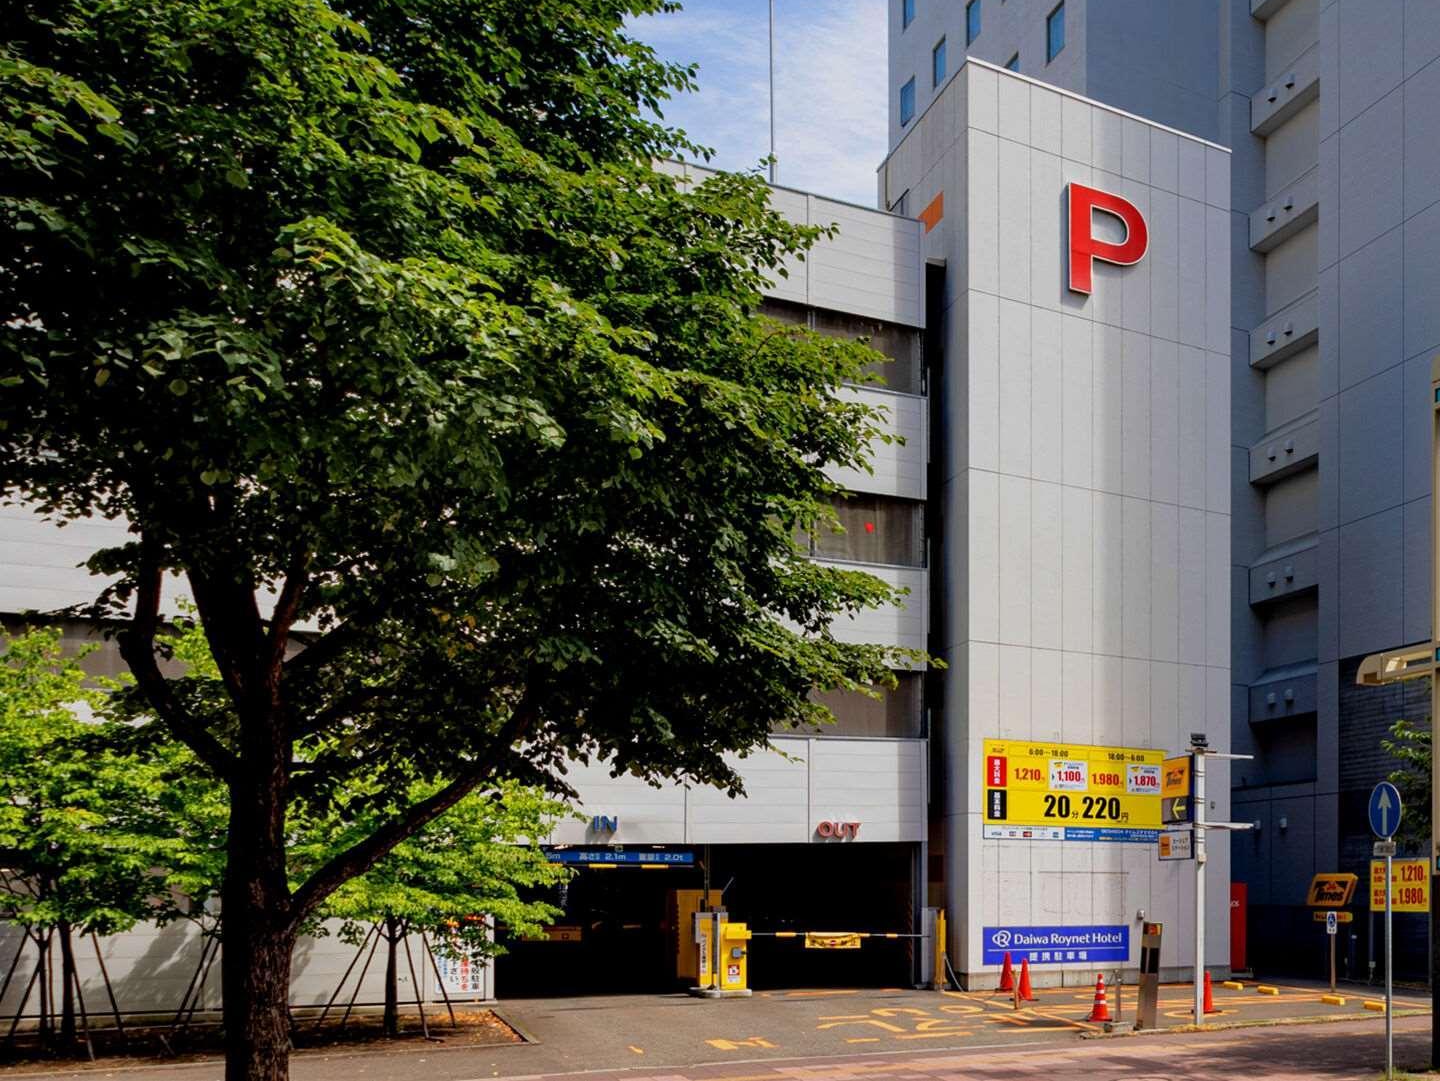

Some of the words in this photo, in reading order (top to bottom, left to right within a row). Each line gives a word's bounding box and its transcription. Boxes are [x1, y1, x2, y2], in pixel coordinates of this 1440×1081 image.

[1067, 182, 1150, 296] P
[593, 815, 618, 833] IN
[817, 821, 862, 838] OUT
[1014, 933, 1049, 945] Daiwa
[1050, 933, 1090, 946] Roynet
[1092, 932, 1122, 944] Hotel
